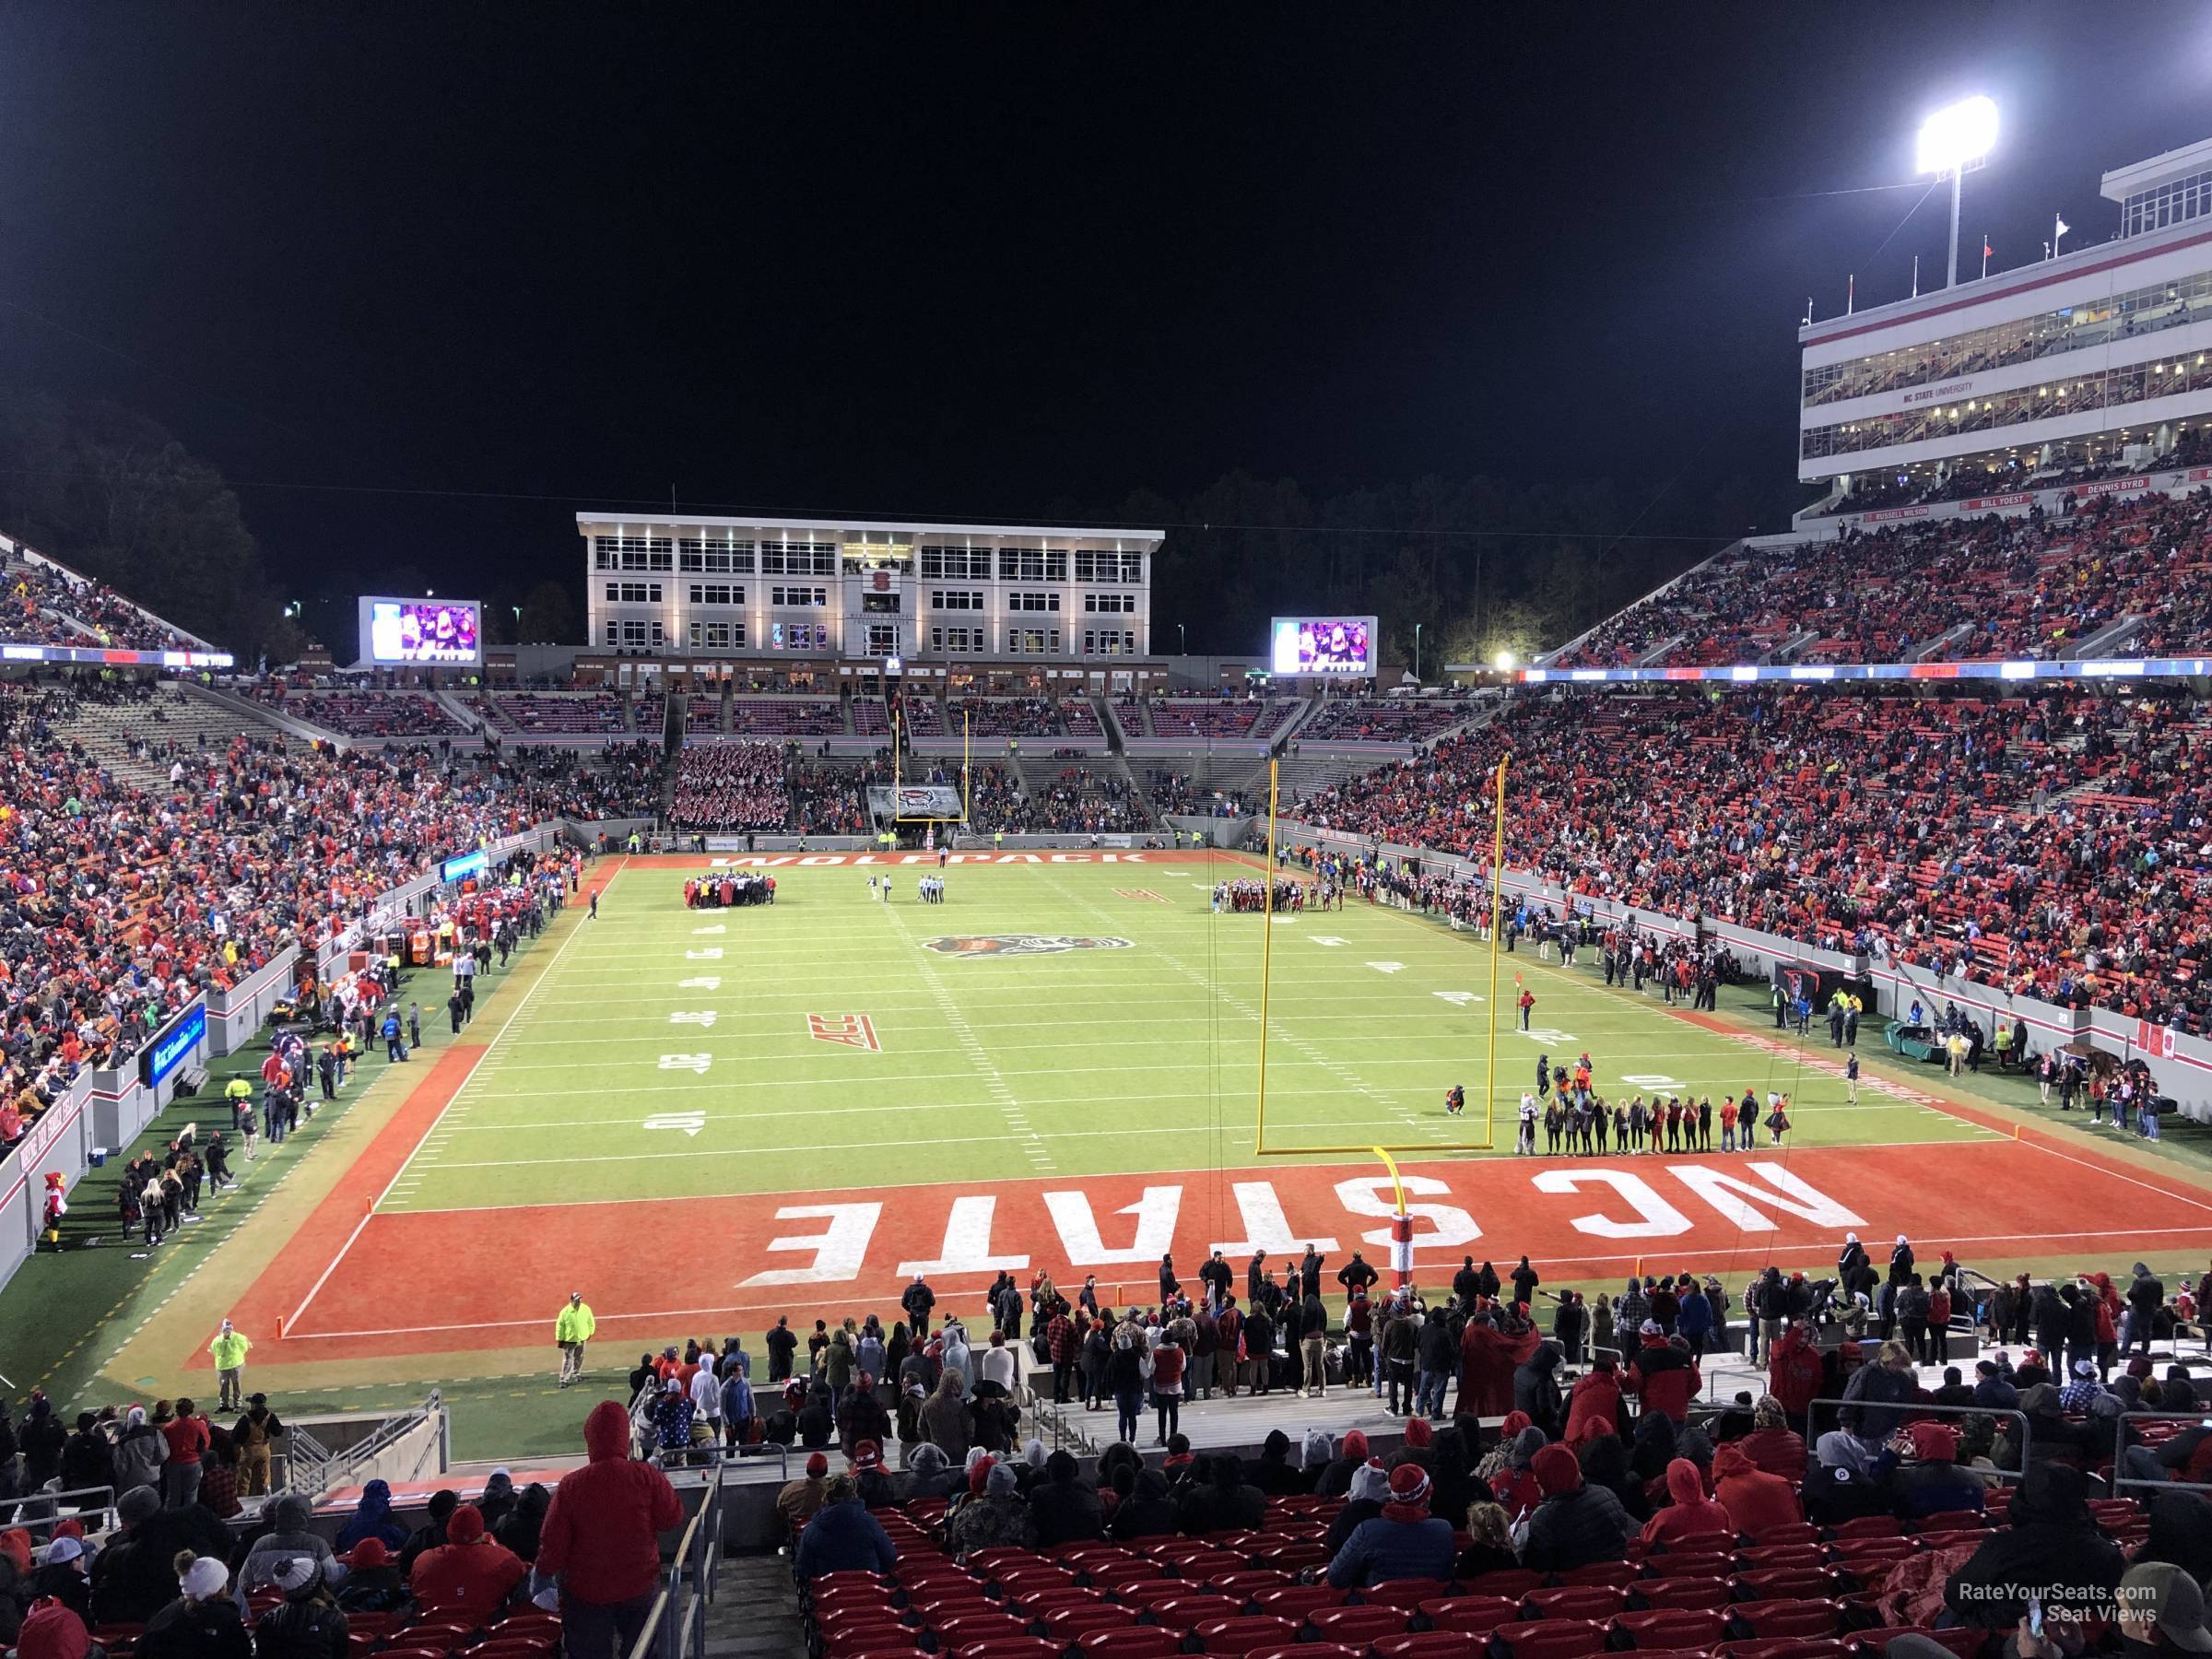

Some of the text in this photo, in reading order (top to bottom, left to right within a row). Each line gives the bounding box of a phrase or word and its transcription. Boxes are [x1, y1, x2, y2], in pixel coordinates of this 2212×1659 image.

[1914, 390, 1934, 401] STATE
[2088, 479, 2144, 494] DENNIS BYRD
[1999, 496, 2024, 504] YOEST
[1876, 508, 1928, 520] RUSSELL WILSON
[709, 851, 1147, 867] WOLFPACK
[806, 1014, 865, 1048] ACC
[658, 1053, 712, 1068] 20
[1621, 1075, 1687, 1089] 10
[642, 1111, 707, 1129] 10
[735, 1161, 1868, 1288] NC STATE
